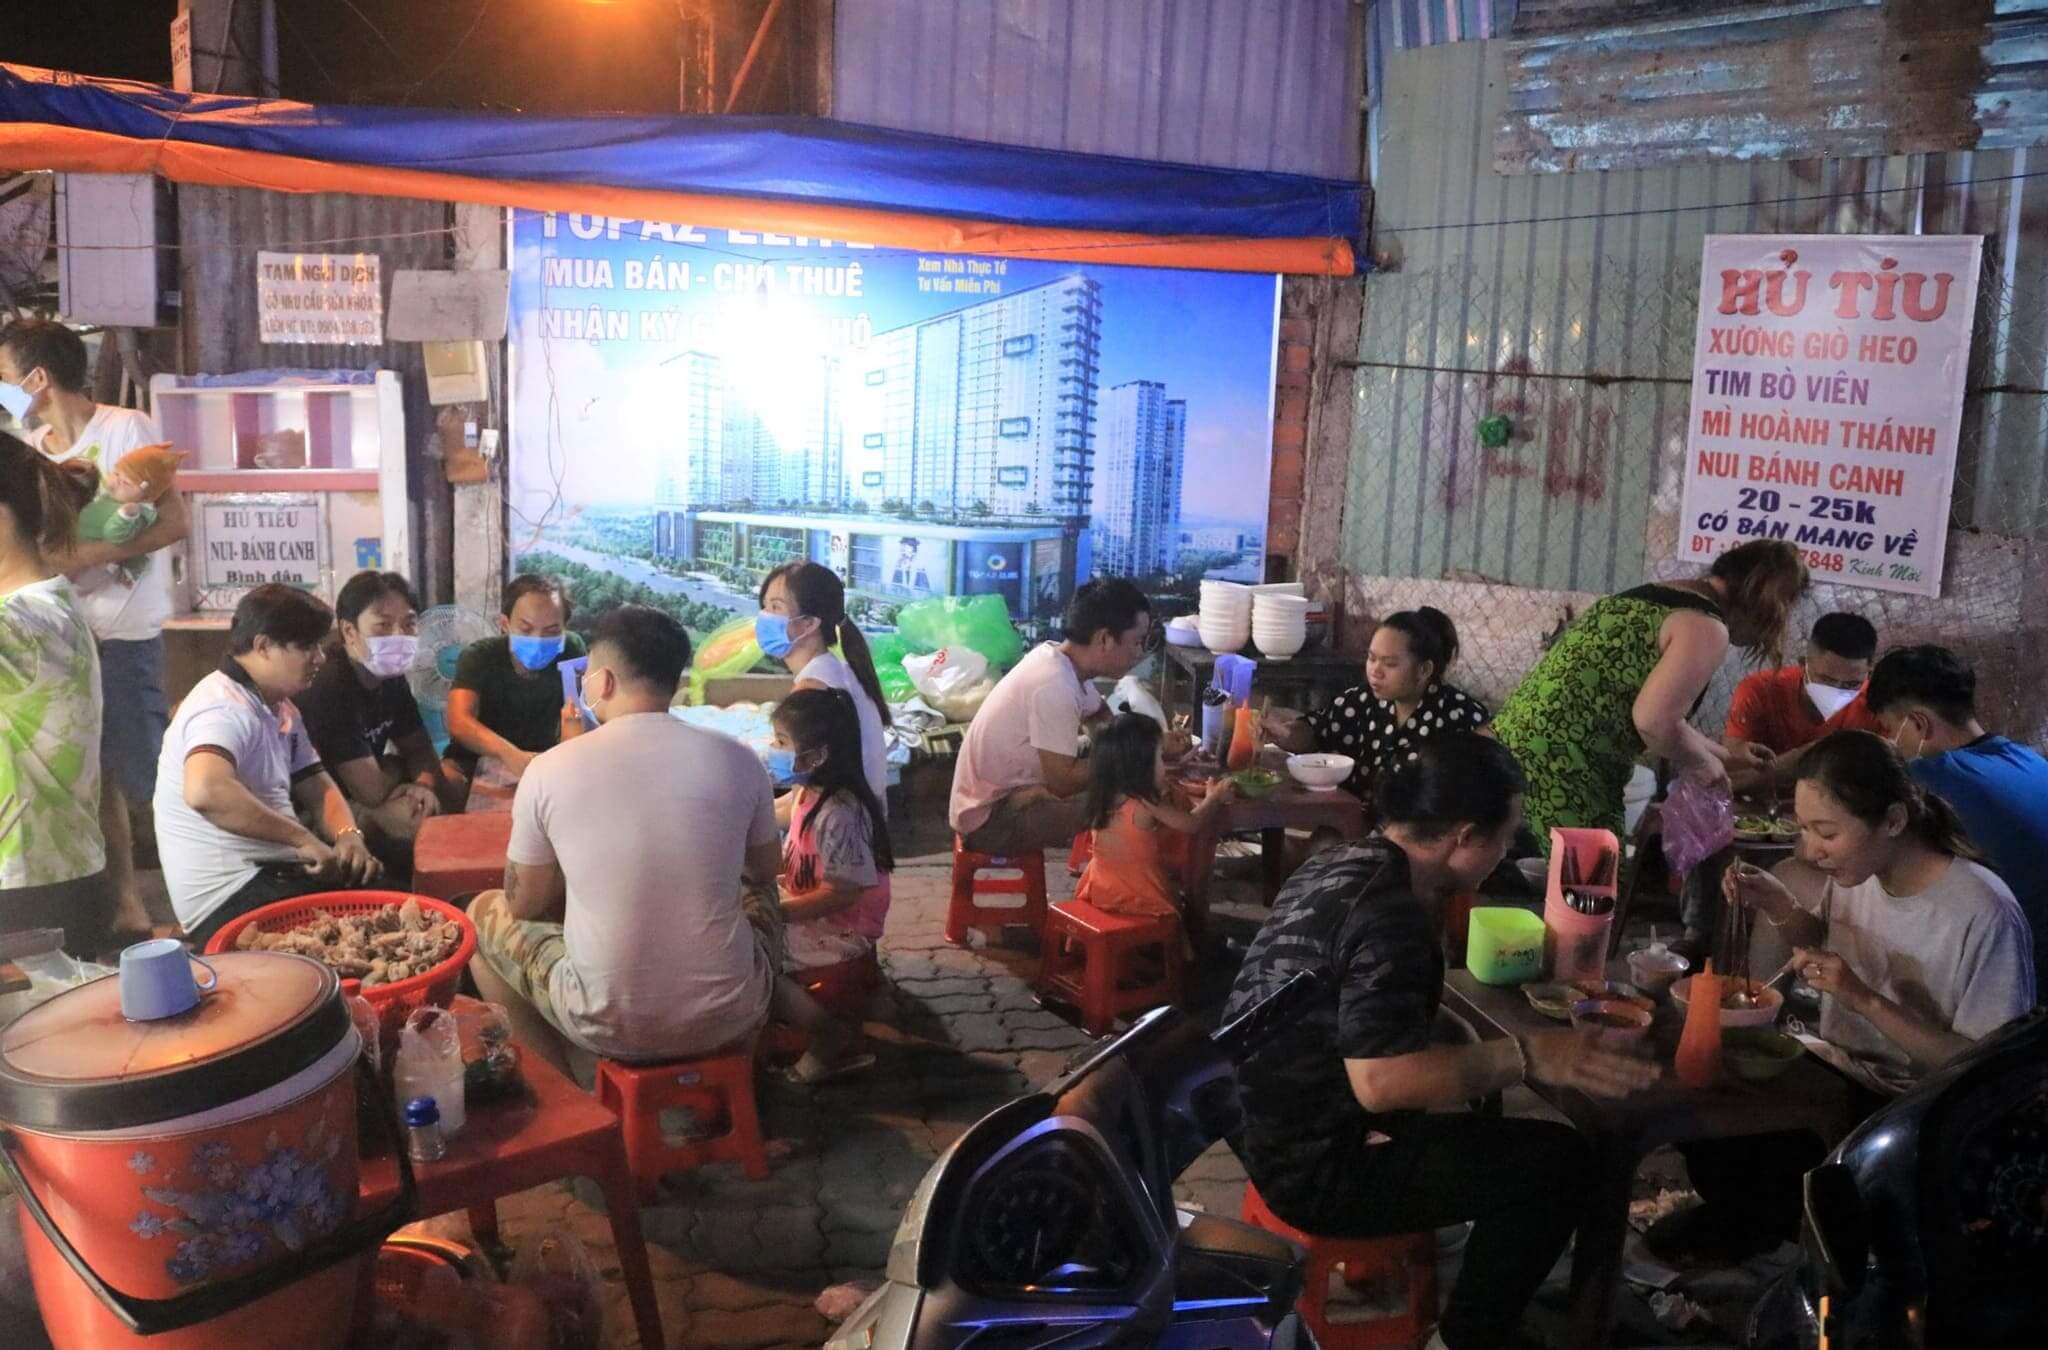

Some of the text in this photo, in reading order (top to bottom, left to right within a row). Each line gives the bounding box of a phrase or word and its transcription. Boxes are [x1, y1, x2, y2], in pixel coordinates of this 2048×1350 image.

[545, 257, 614, 290] MUA
[624, 254, 690, 292] BÁN
[786, 262, 865, 297] THUÊ
[918, 257, 942, 273] Xem
[1717, 249, 1812, 317] HỦ
[1709, 324, 1918, 365] XƯƠNG GIÒ HEO
[1705, 366, 1870, 406] TIM BÒ VIÊN
[1701, 405, 1936, 456] MÌ HOÀNH THÁNH
[1697, 450, 1905, 497] NUI BÁNH CANH
[1737, 487, 1781, 513] 20
[240, 535, 276, 561] BÁNH
[278, 540, 316, 561] CANH
[1691, 534, 1714, 555] ĐT
[1697, 509, 1920, 557] CÓ BÁN MANG VỀ
[226, 569, 303, 584] Bình dân
